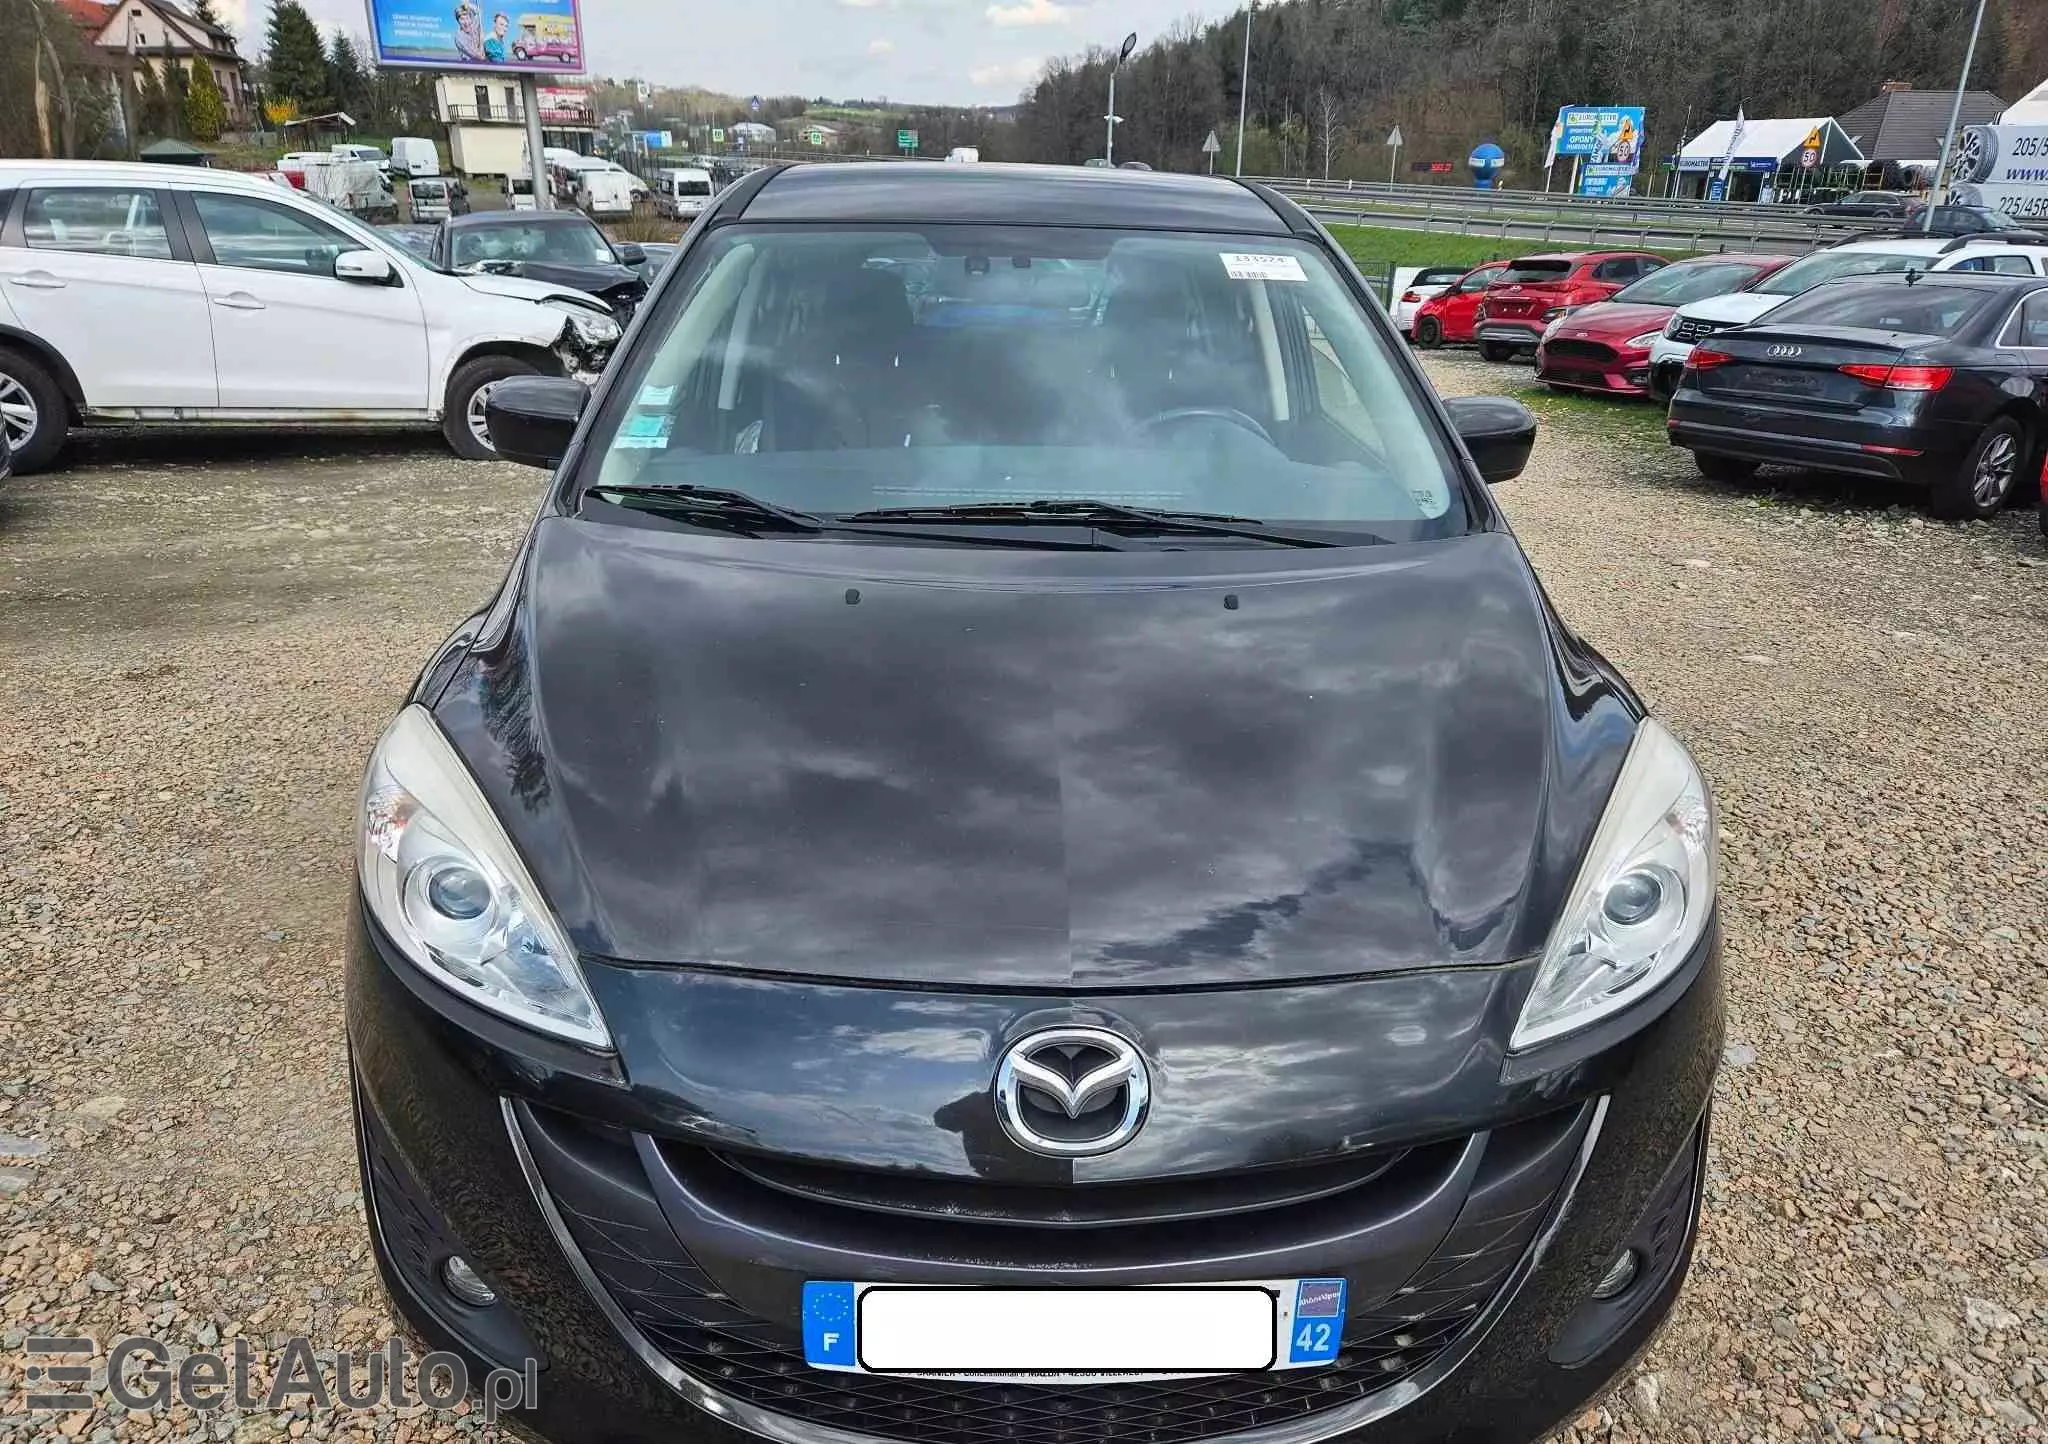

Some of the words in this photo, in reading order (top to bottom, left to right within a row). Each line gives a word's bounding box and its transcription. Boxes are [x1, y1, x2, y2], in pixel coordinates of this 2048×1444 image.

[1619, 144, 1630, 156] 50
[1804, 152, 1816, 162] 50
[823, 1332, 840, 1352] F
[1295, 1323, 1331, 1352] 42
